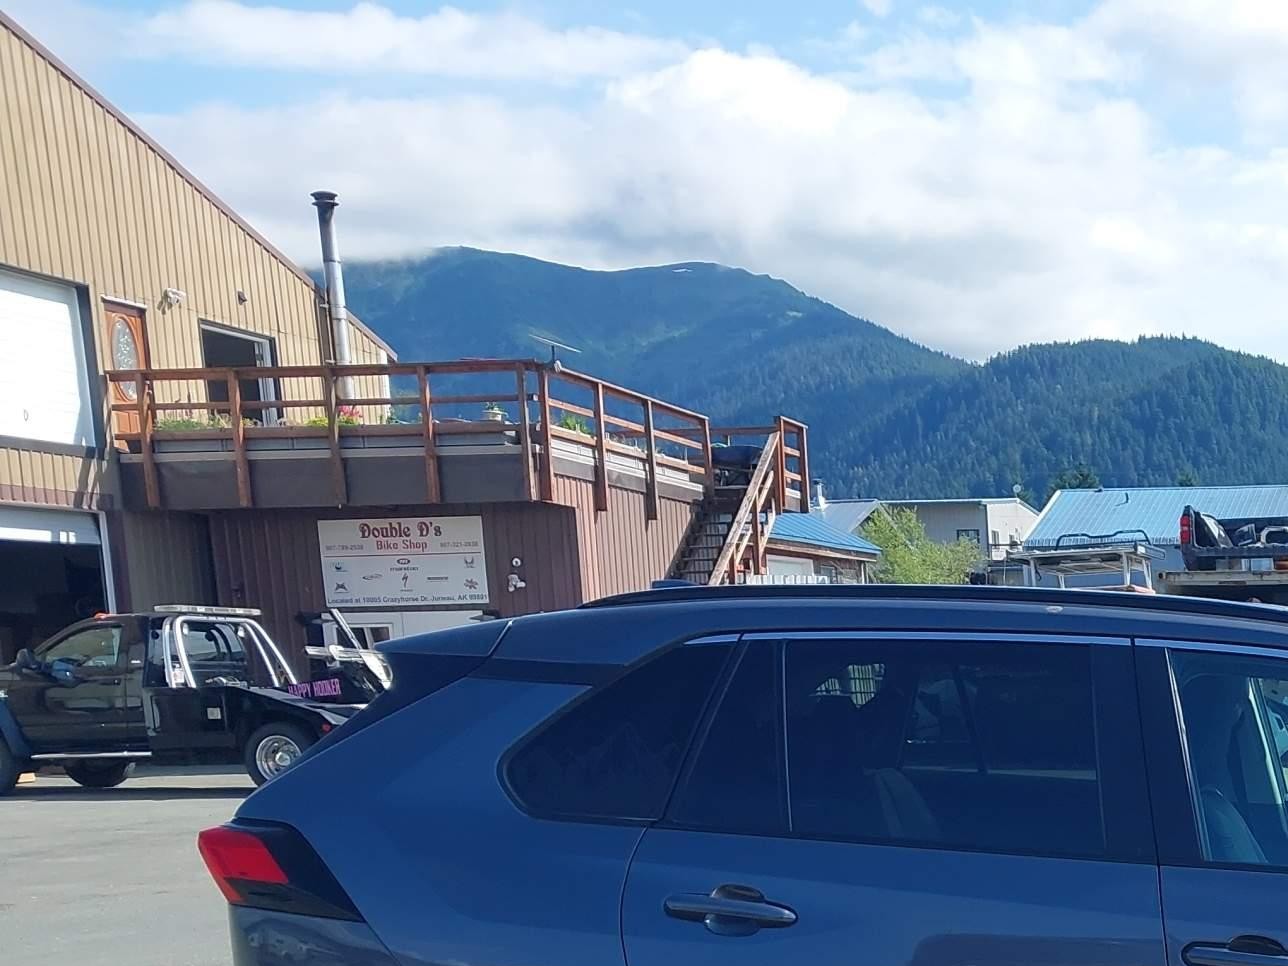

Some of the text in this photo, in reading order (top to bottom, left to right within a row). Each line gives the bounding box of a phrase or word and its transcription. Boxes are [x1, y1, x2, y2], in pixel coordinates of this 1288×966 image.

[359, 521, 442, 538] Double D's
[376, 538, 428, 552] Bike Shop
[288, 679, 341, 697] HAPPY HOOKER
